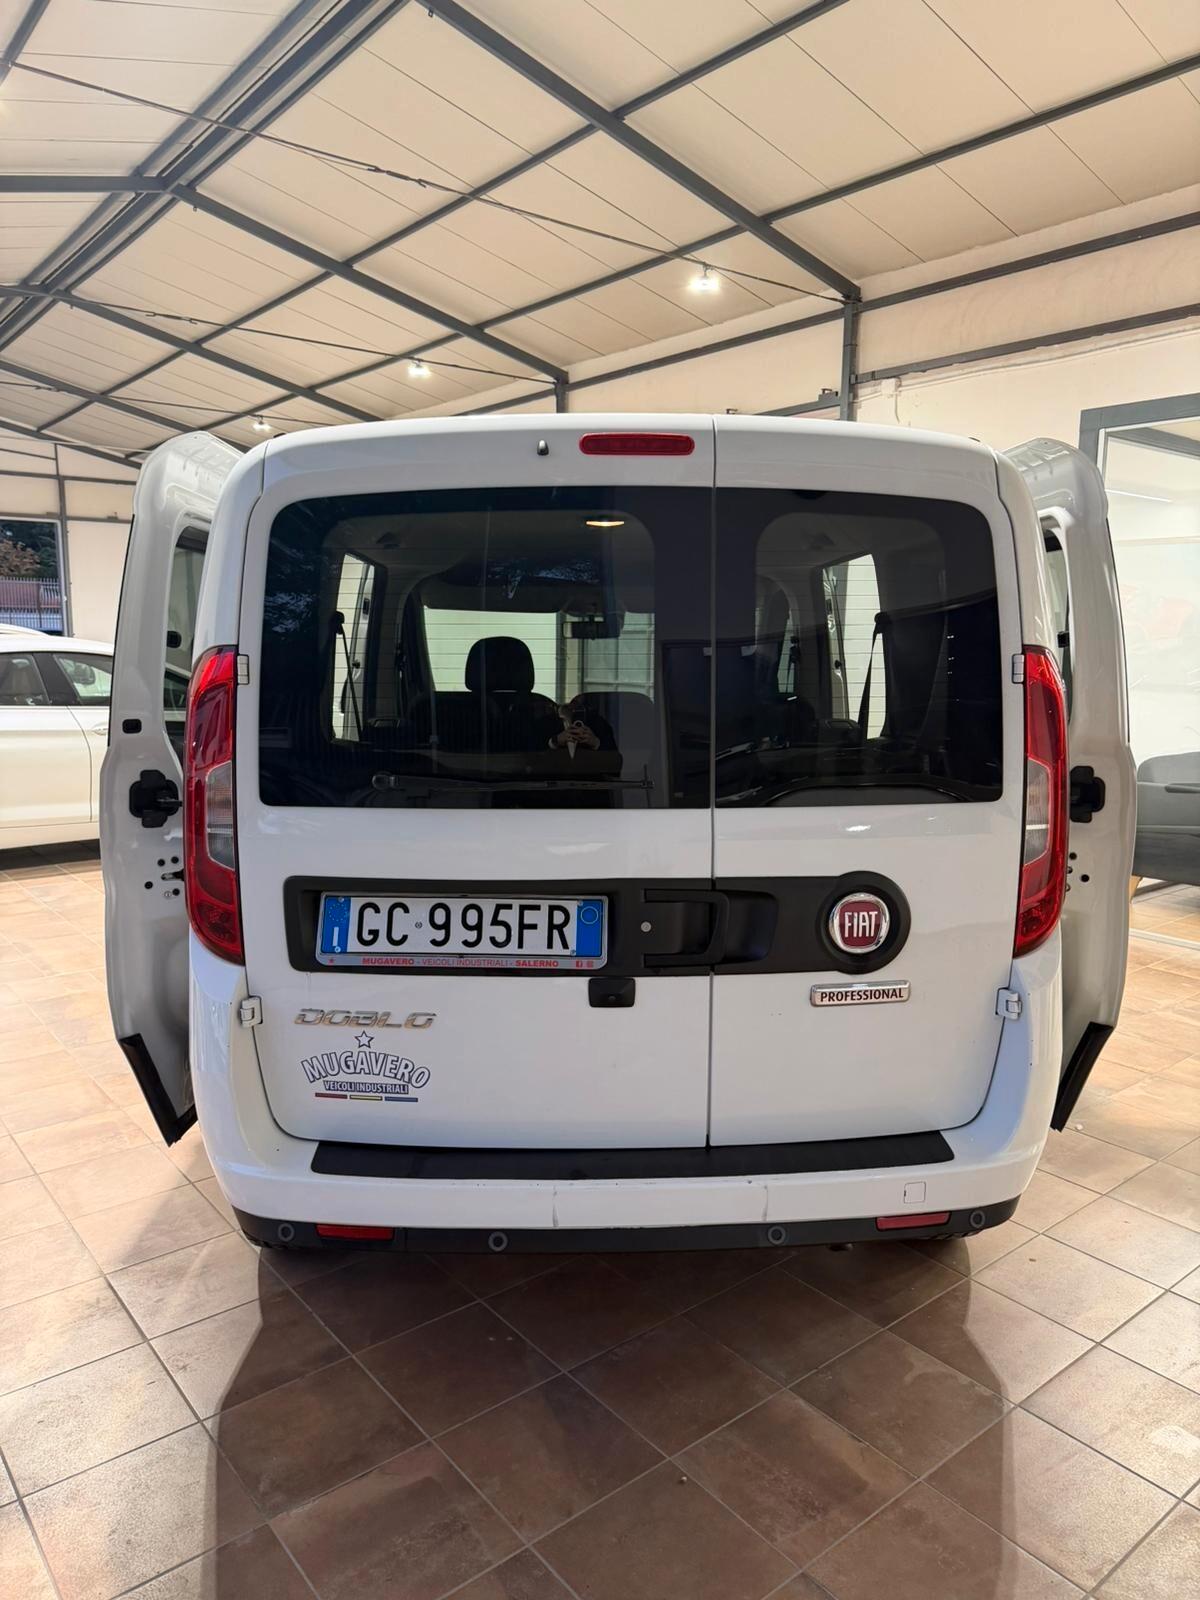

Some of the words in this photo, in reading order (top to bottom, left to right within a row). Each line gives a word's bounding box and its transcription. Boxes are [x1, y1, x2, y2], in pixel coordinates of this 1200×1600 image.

[356, 902, 410, 947] GC
[428, 903, 571, 950] 995FR
[844, 911, 878, 938] FIAT
[362, 957, 415, 966] MUGAVERO
[422, 958, 455, 967] VEICOLI
[456, 959, 508, 968] INDUSTRIALI
[515, 959, 559, 968] SALERNO
[820, 988, 904, 1003] PROFESSIONAL
[301, 1050, 431, 1089] MUGAVERO
[323, 1081, 355, 1092] VEICOLI
[356, 1082, 409, 1095] INDUSTRIALI
